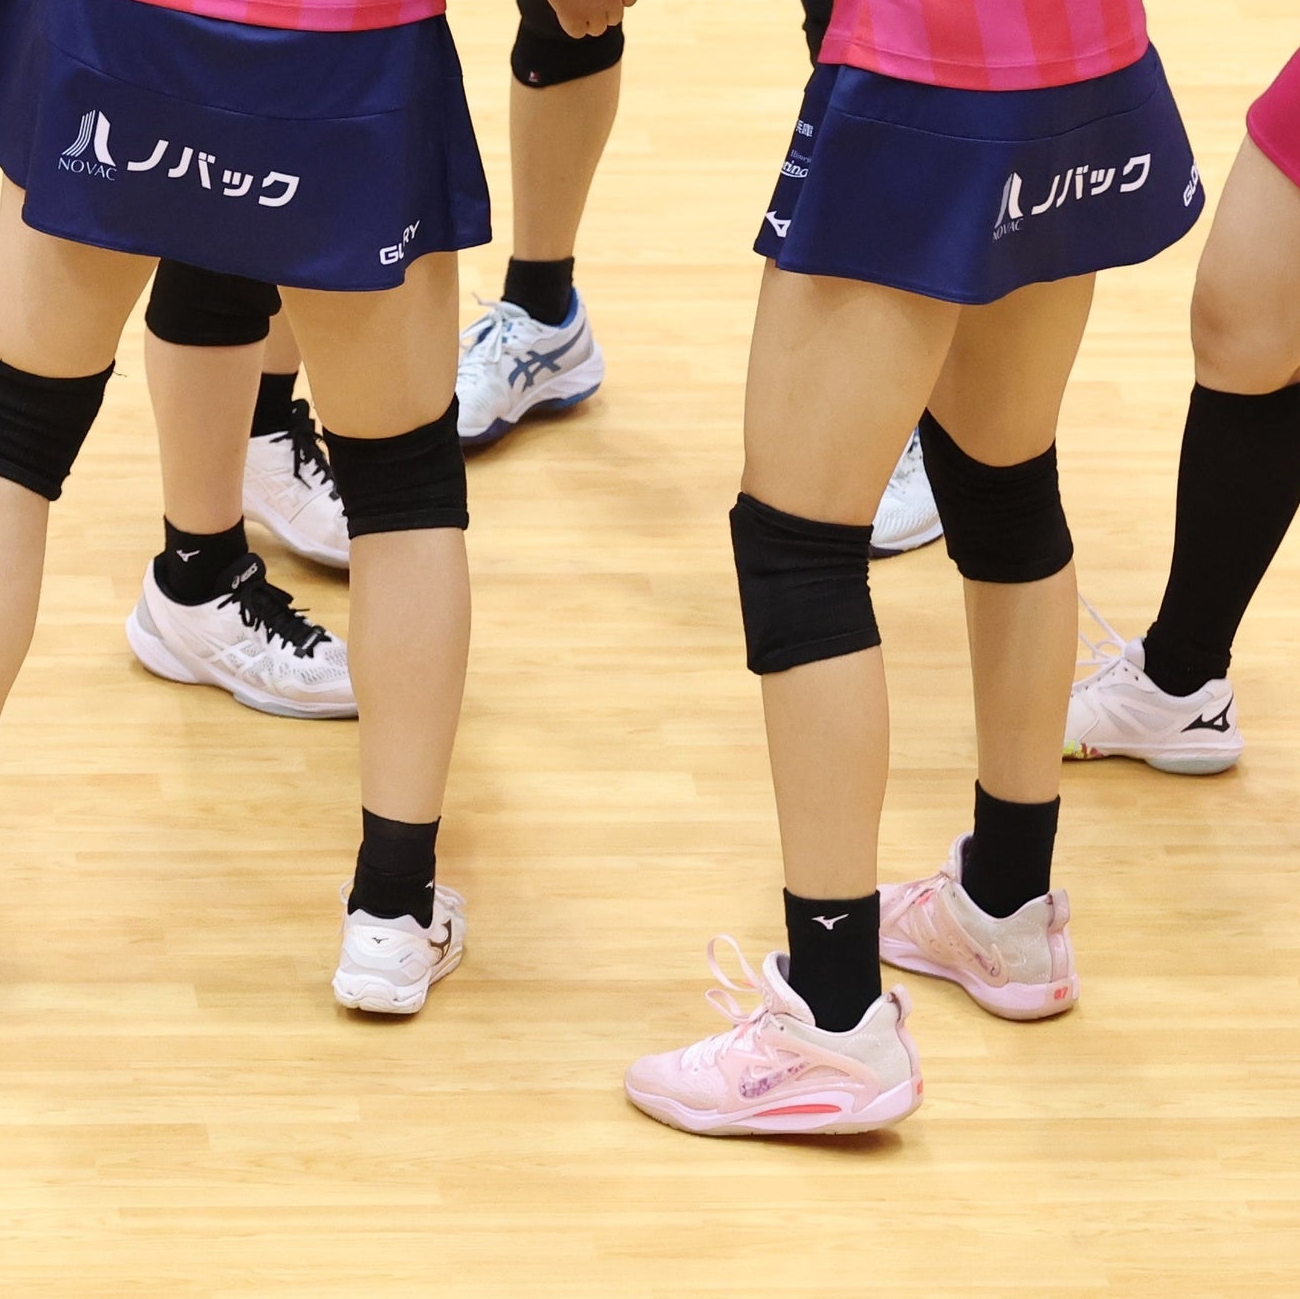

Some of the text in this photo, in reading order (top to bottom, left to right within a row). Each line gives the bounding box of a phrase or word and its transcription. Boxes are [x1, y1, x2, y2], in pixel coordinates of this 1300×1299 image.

[58, 157, 117, 181] NOVAC
[127, 139, 300, 208] ノバック
[1031, 153, 1151, 215] ノバック
